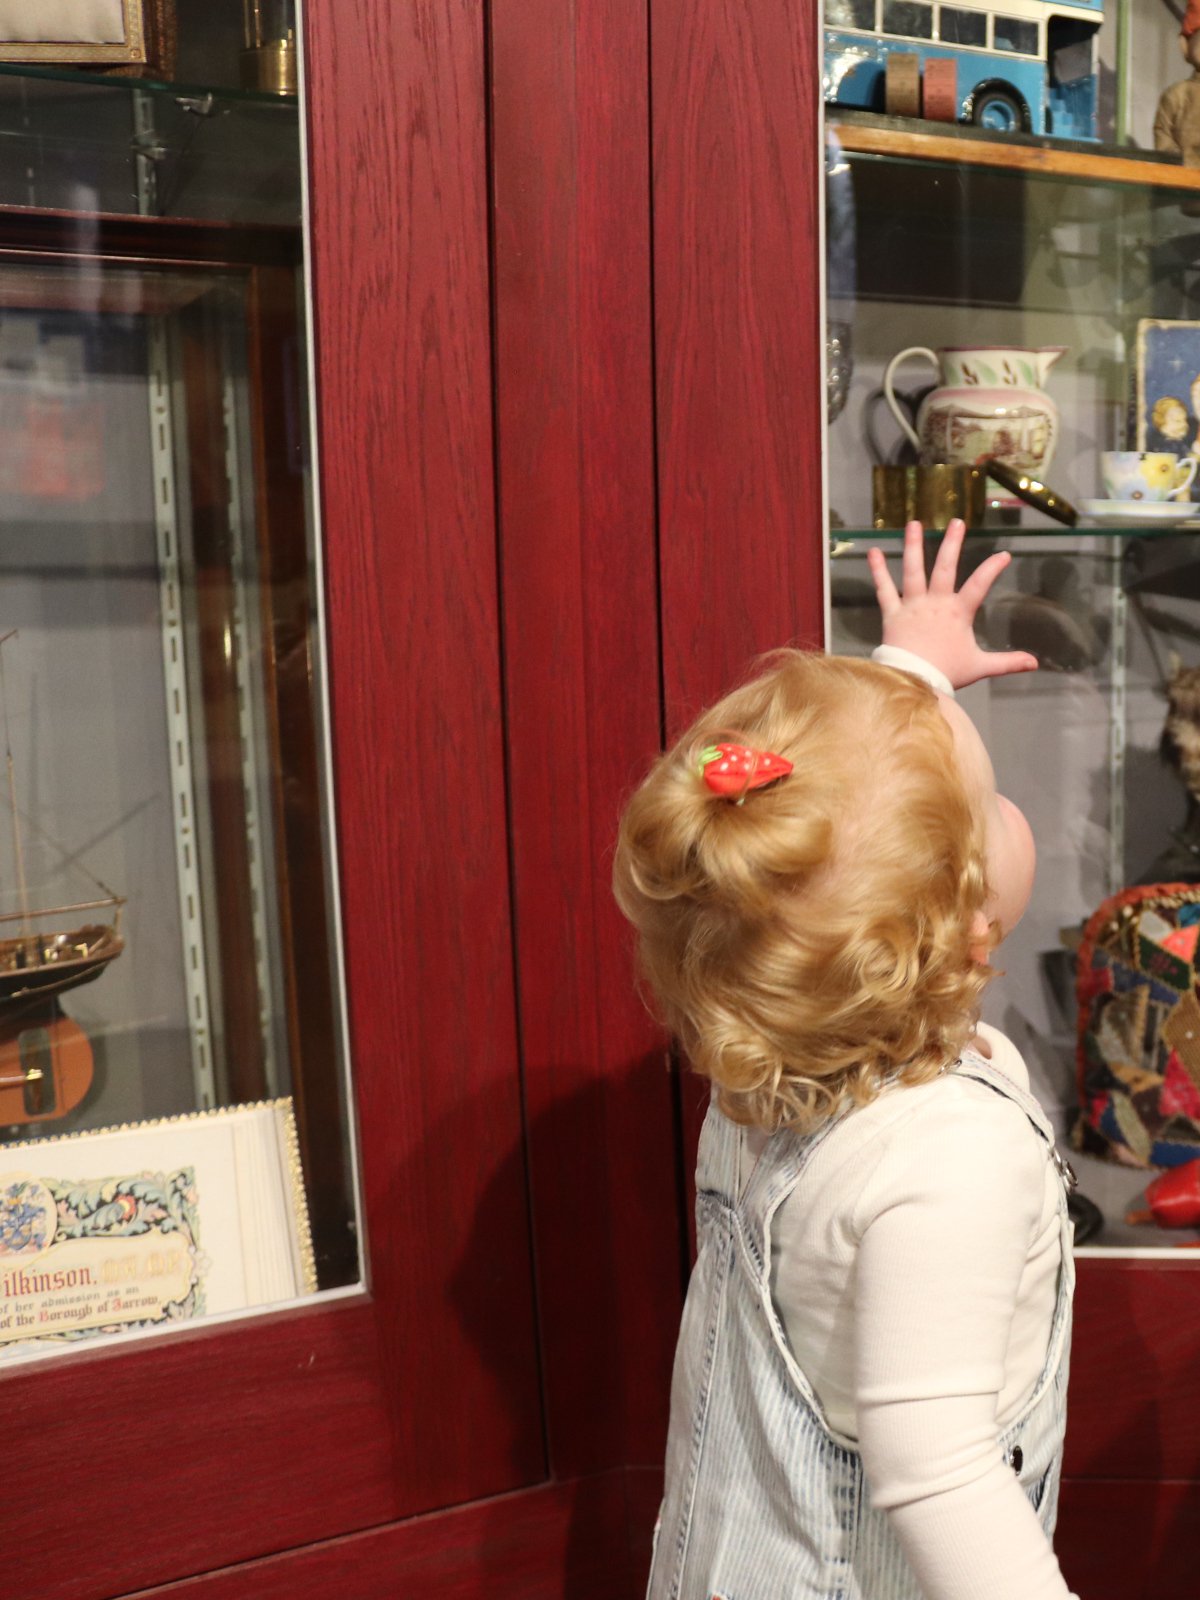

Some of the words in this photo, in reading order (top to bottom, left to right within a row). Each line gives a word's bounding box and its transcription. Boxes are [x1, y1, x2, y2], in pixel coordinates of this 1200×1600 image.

[3, 1268, 97, 1297] ilkinson.
[0, 1315, 12, 1329] of
[16, 1314, 35, 1327] the
[39, 1303, 93, 1322] Borough
[97, 1300, 109, 1313] of
